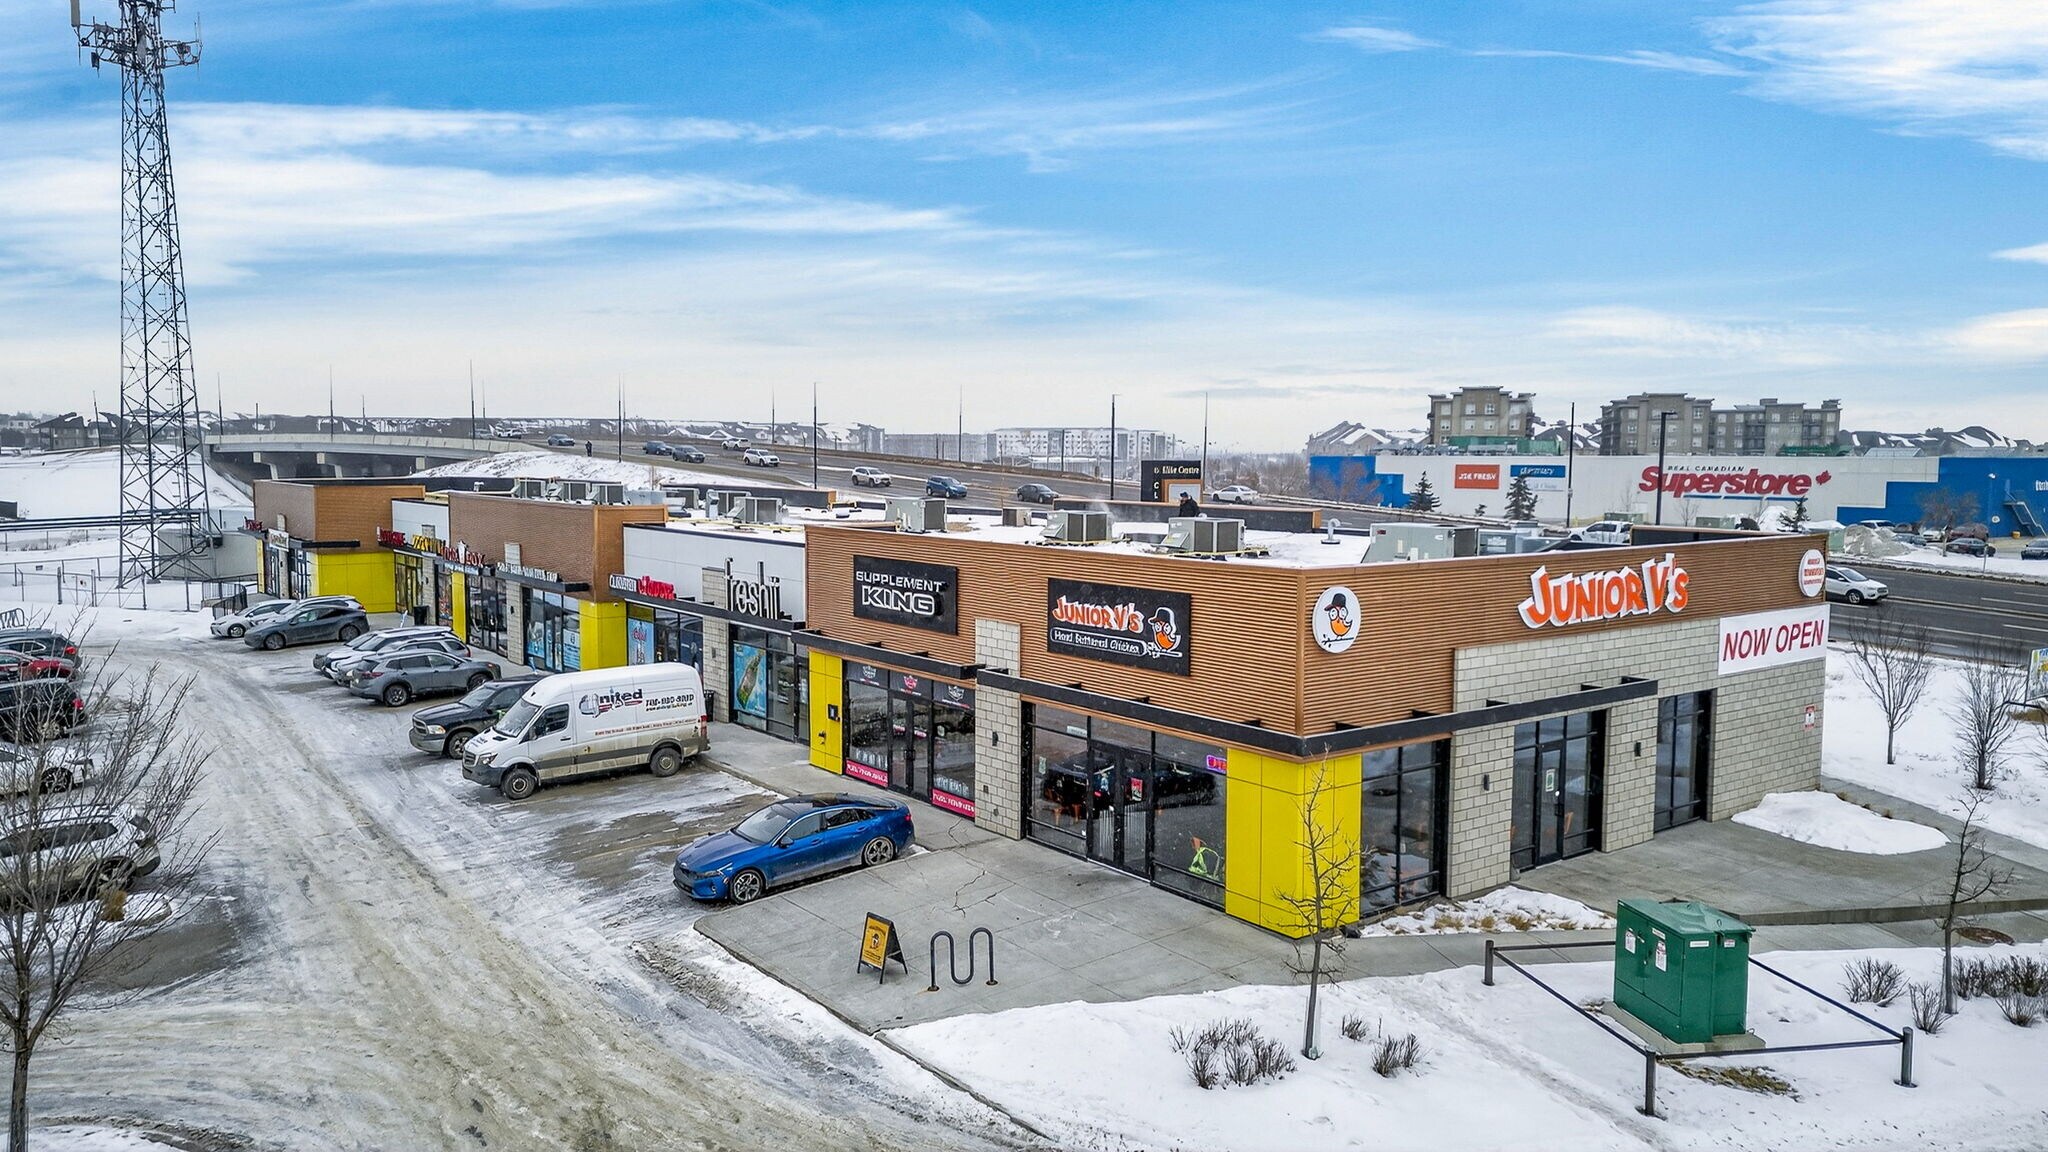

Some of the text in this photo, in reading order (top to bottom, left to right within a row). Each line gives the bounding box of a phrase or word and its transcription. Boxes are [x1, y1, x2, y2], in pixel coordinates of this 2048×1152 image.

[1639, 466, 1812, 498] Superstore
[724, 557, 780, 620] freshii
[856, 570, 943, 592] SUPPLEMENT
[1518, 565, 1647, 629] JUNIOR
[862, 585, 936, 616] KING
[1052, 595, 1114, 630] JUNIOR
[1722, 619, 1824, 662] NOW OPEN
